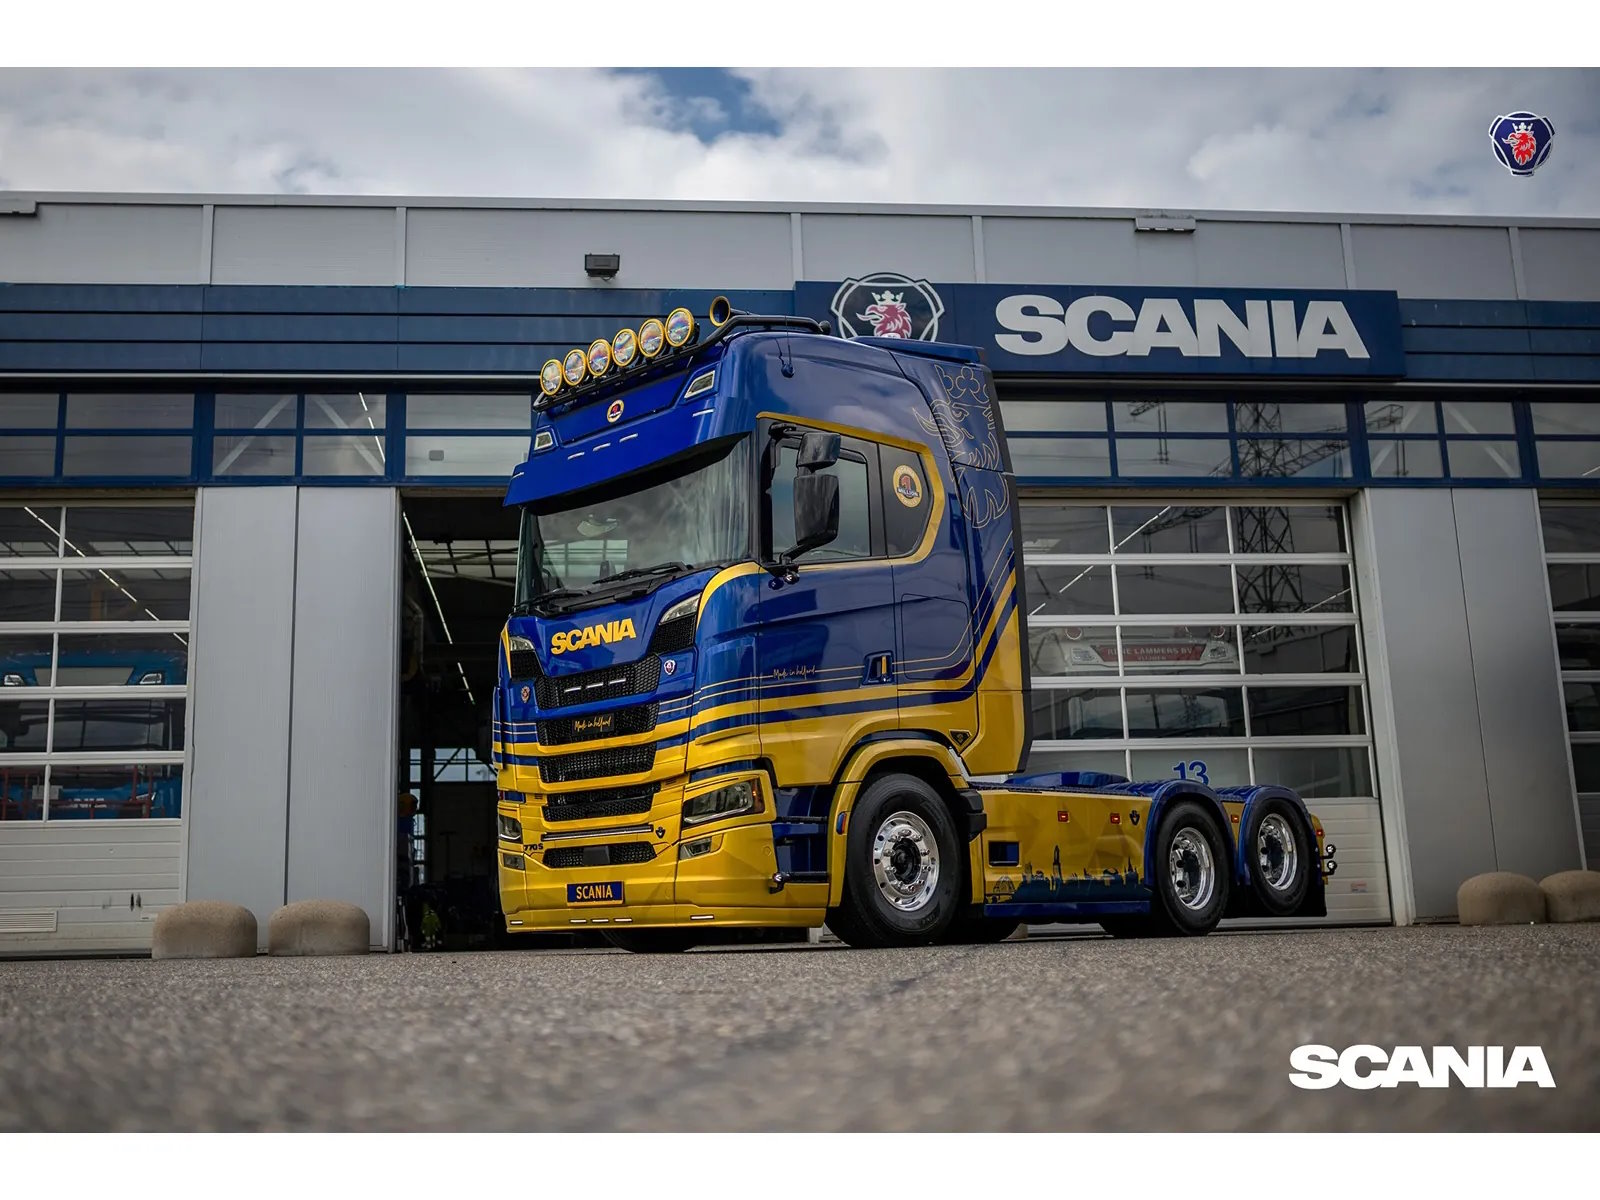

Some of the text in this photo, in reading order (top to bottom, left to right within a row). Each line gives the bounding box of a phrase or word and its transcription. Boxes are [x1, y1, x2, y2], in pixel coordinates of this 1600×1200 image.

[994, 294, 1370, 359] SCANIA
[551, 617, 636, 655] SCANIA
[1173, 760, 1210, 786] 13
[576, 884, 614, 900] SCANIA
